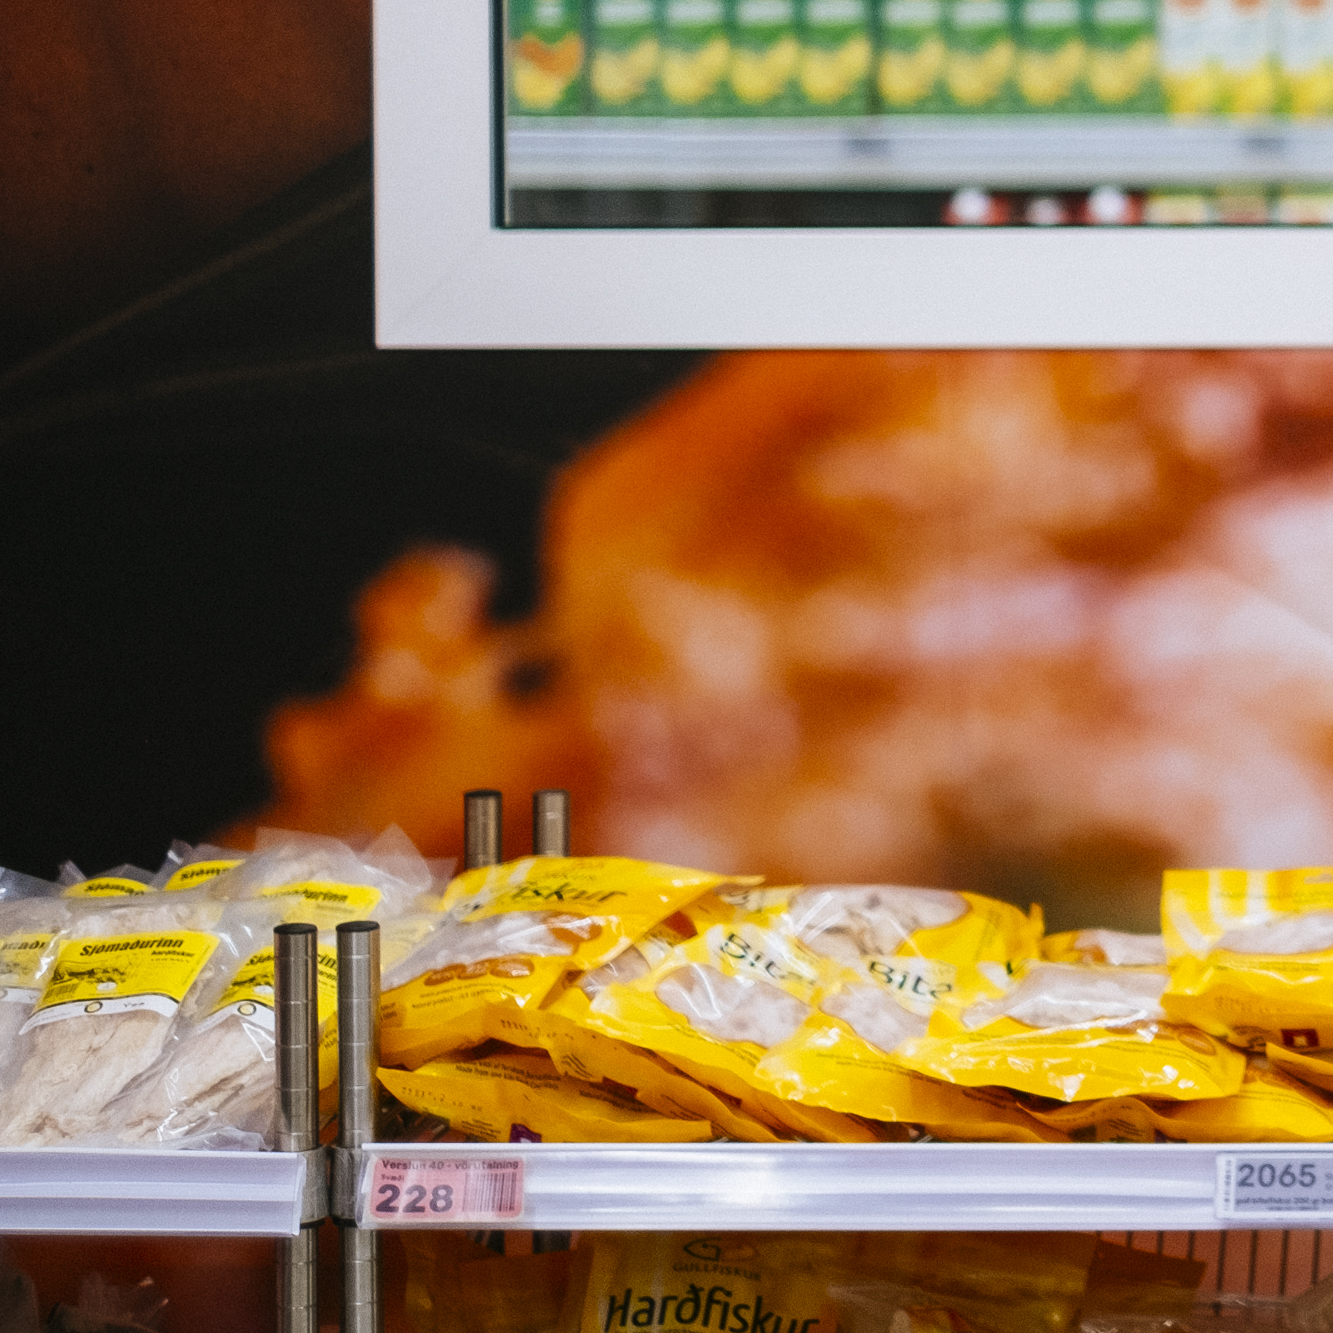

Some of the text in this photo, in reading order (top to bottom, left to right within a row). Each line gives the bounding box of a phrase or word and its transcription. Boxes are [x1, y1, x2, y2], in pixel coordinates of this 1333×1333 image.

[430, 1160, 445, 1170] 40
[1237, 1163, 1317, 1188] 2065
[376, 1183, 454, 1213] 228
